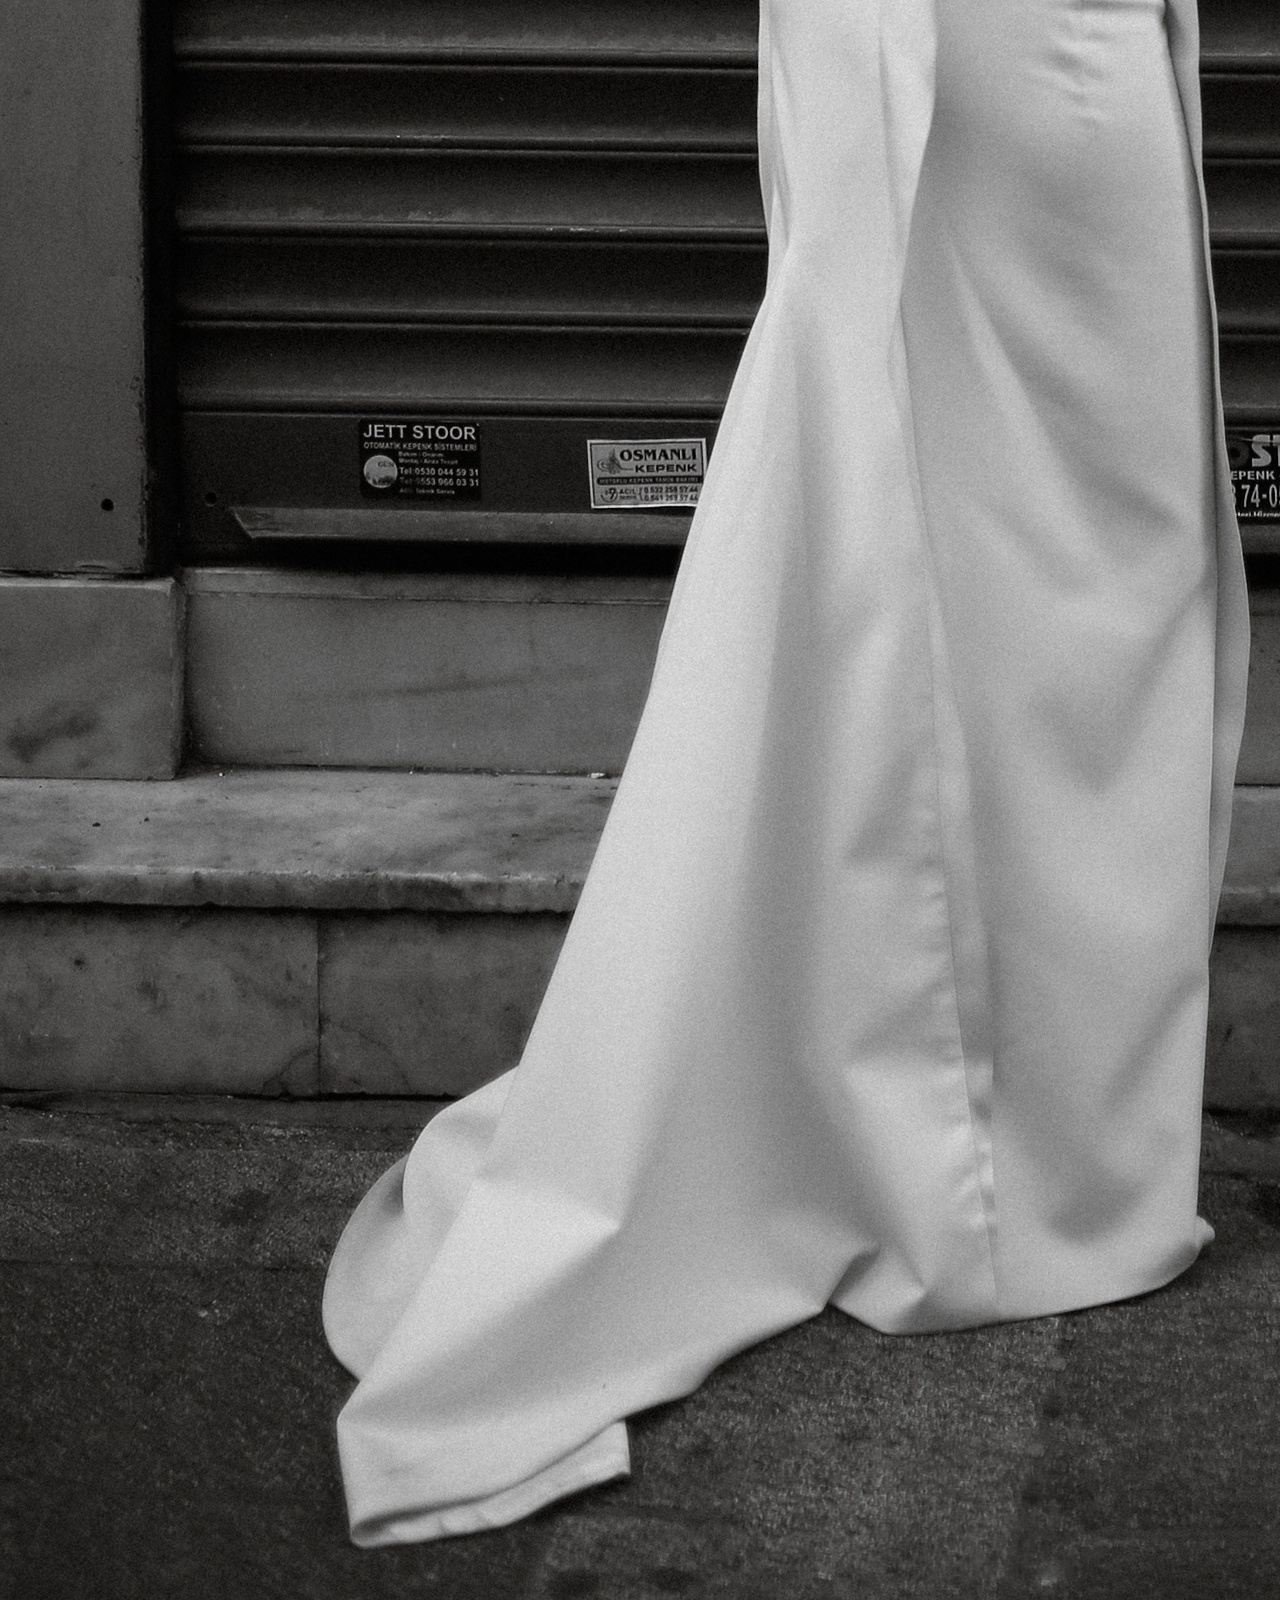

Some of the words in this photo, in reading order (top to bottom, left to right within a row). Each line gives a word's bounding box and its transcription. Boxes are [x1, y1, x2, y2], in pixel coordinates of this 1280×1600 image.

[363, 424, 407, 438] JETT
[412, 426, 476, 440] STOOR
[403, 442, 432, 450] KEPENK
[620, 449, 697, 461] OSMANLI
[635, 464, 698, 473] KEPENK
